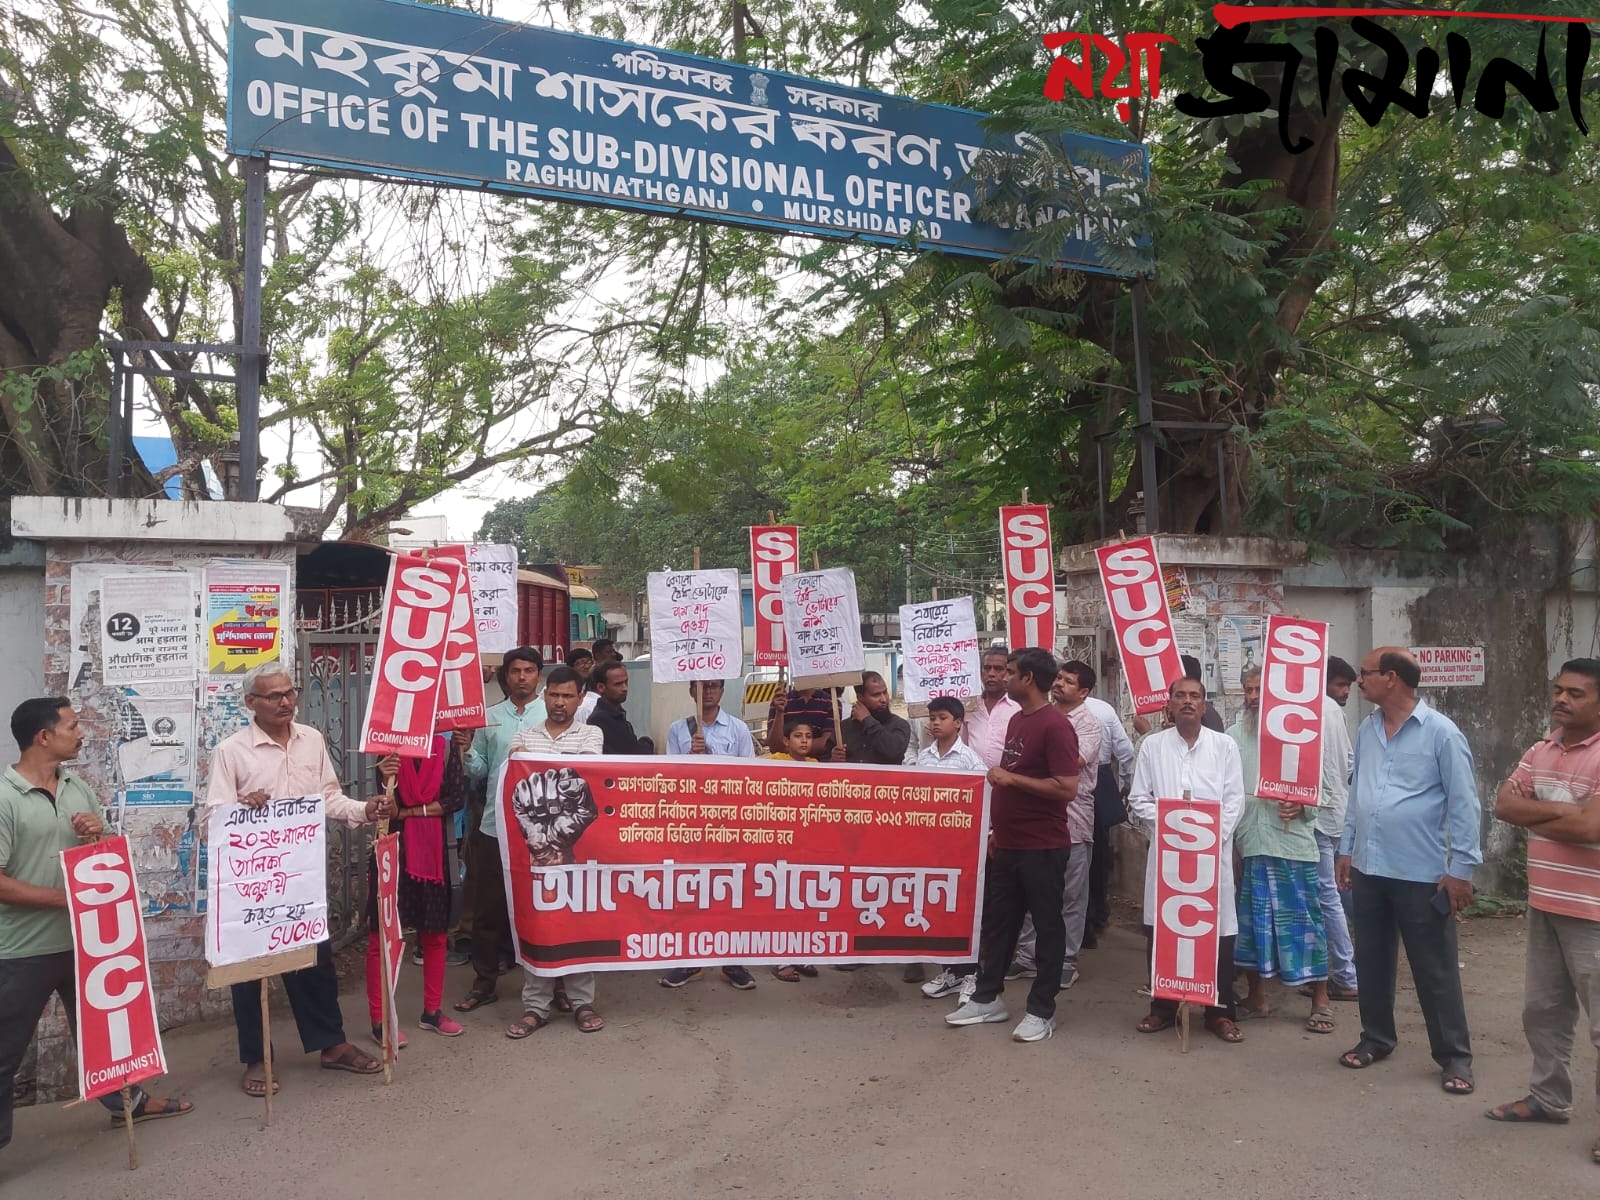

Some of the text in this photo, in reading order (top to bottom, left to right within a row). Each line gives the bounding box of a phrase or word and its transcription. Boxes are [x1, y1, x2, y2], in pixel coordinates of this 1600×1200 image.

[240, 15, 521, 104] মহকুমা
[529, 66, 781, 150] শাসকের
[789, 112, 952, 181] করণ,
[612, 50, 882, 122] পশ্চিমবঙ্গ সরকার
[247, 79, 391, 136] OFFICE
[401, 103, 449, 144] OF
[460, 112, 540, 159] THE
[548, 127, 835, 203] SUB-DIVISIONAL
[845, 174, 972, 224] OFFICER
[505, 159, 942, 240] RAGHUNATHGANJ MURSHIDABAD
[489, 561, 513, 574] করে
[1006, 514, 1052, 653] SUCI
[111, 617, 133, 631] 12
[912, 603, 954, 622] এবারের
[1105, 547, 1171, 692] SUCI
[136, 636, 154, 645] आम
[384, 566, 453, 733] SUCI
[799, 644, 825, 656] চলবে
[909, 653, 952, 667] তালিকা
[1419, 649, 1472, 663] NO PARKING
[1266, 624, 1322, 783] SUCI
[367, 726, 429, 752] (COMMUNIST)
[617, 773, 677, 795] অগণতান্ত্রিক
[679, 778, 697, 794] SIR
[721, 779, 742, 795] নামে
[746, 776, 763, 796] বৈধ
[766, 777, 813, 798] ভোটারদের
[816, 779, 872, 800] ভোটাধিকার
[874, 785, 899, 804] কেড়ে
[902, 786, 931, 804] নেওয়া
[933, 787, 960, 803] চলবে
[962, 788, 973, 803] না
[1259, 777, 1318, 801] (COMMUNIST)
[619, 799, 973, 829] এবারের নির্বাচনে সকলের ভোটাধিকার সুনিশ্চিত করতে ২০২৫ সালের ভোটার
[619, 822, 795, 845] তালিকার ভিত্তিতে নির্বাচন করাতে হবে
[229, 847, 291, 877] তালিকা
[531, 858, 963, 932] আন্দোলন গড়ে তুলুন
[1161, 808, 1217, 980] SUCI
[242, 904, 286, 926] করতে
[73, 851, 144, 1062] SUCI
[626, 931, 683, 959] SUCI
[1154, 973, 1214, 998] (COMMUNIST)
[85, 1047, 160, 1090] (COMMUNIST)
